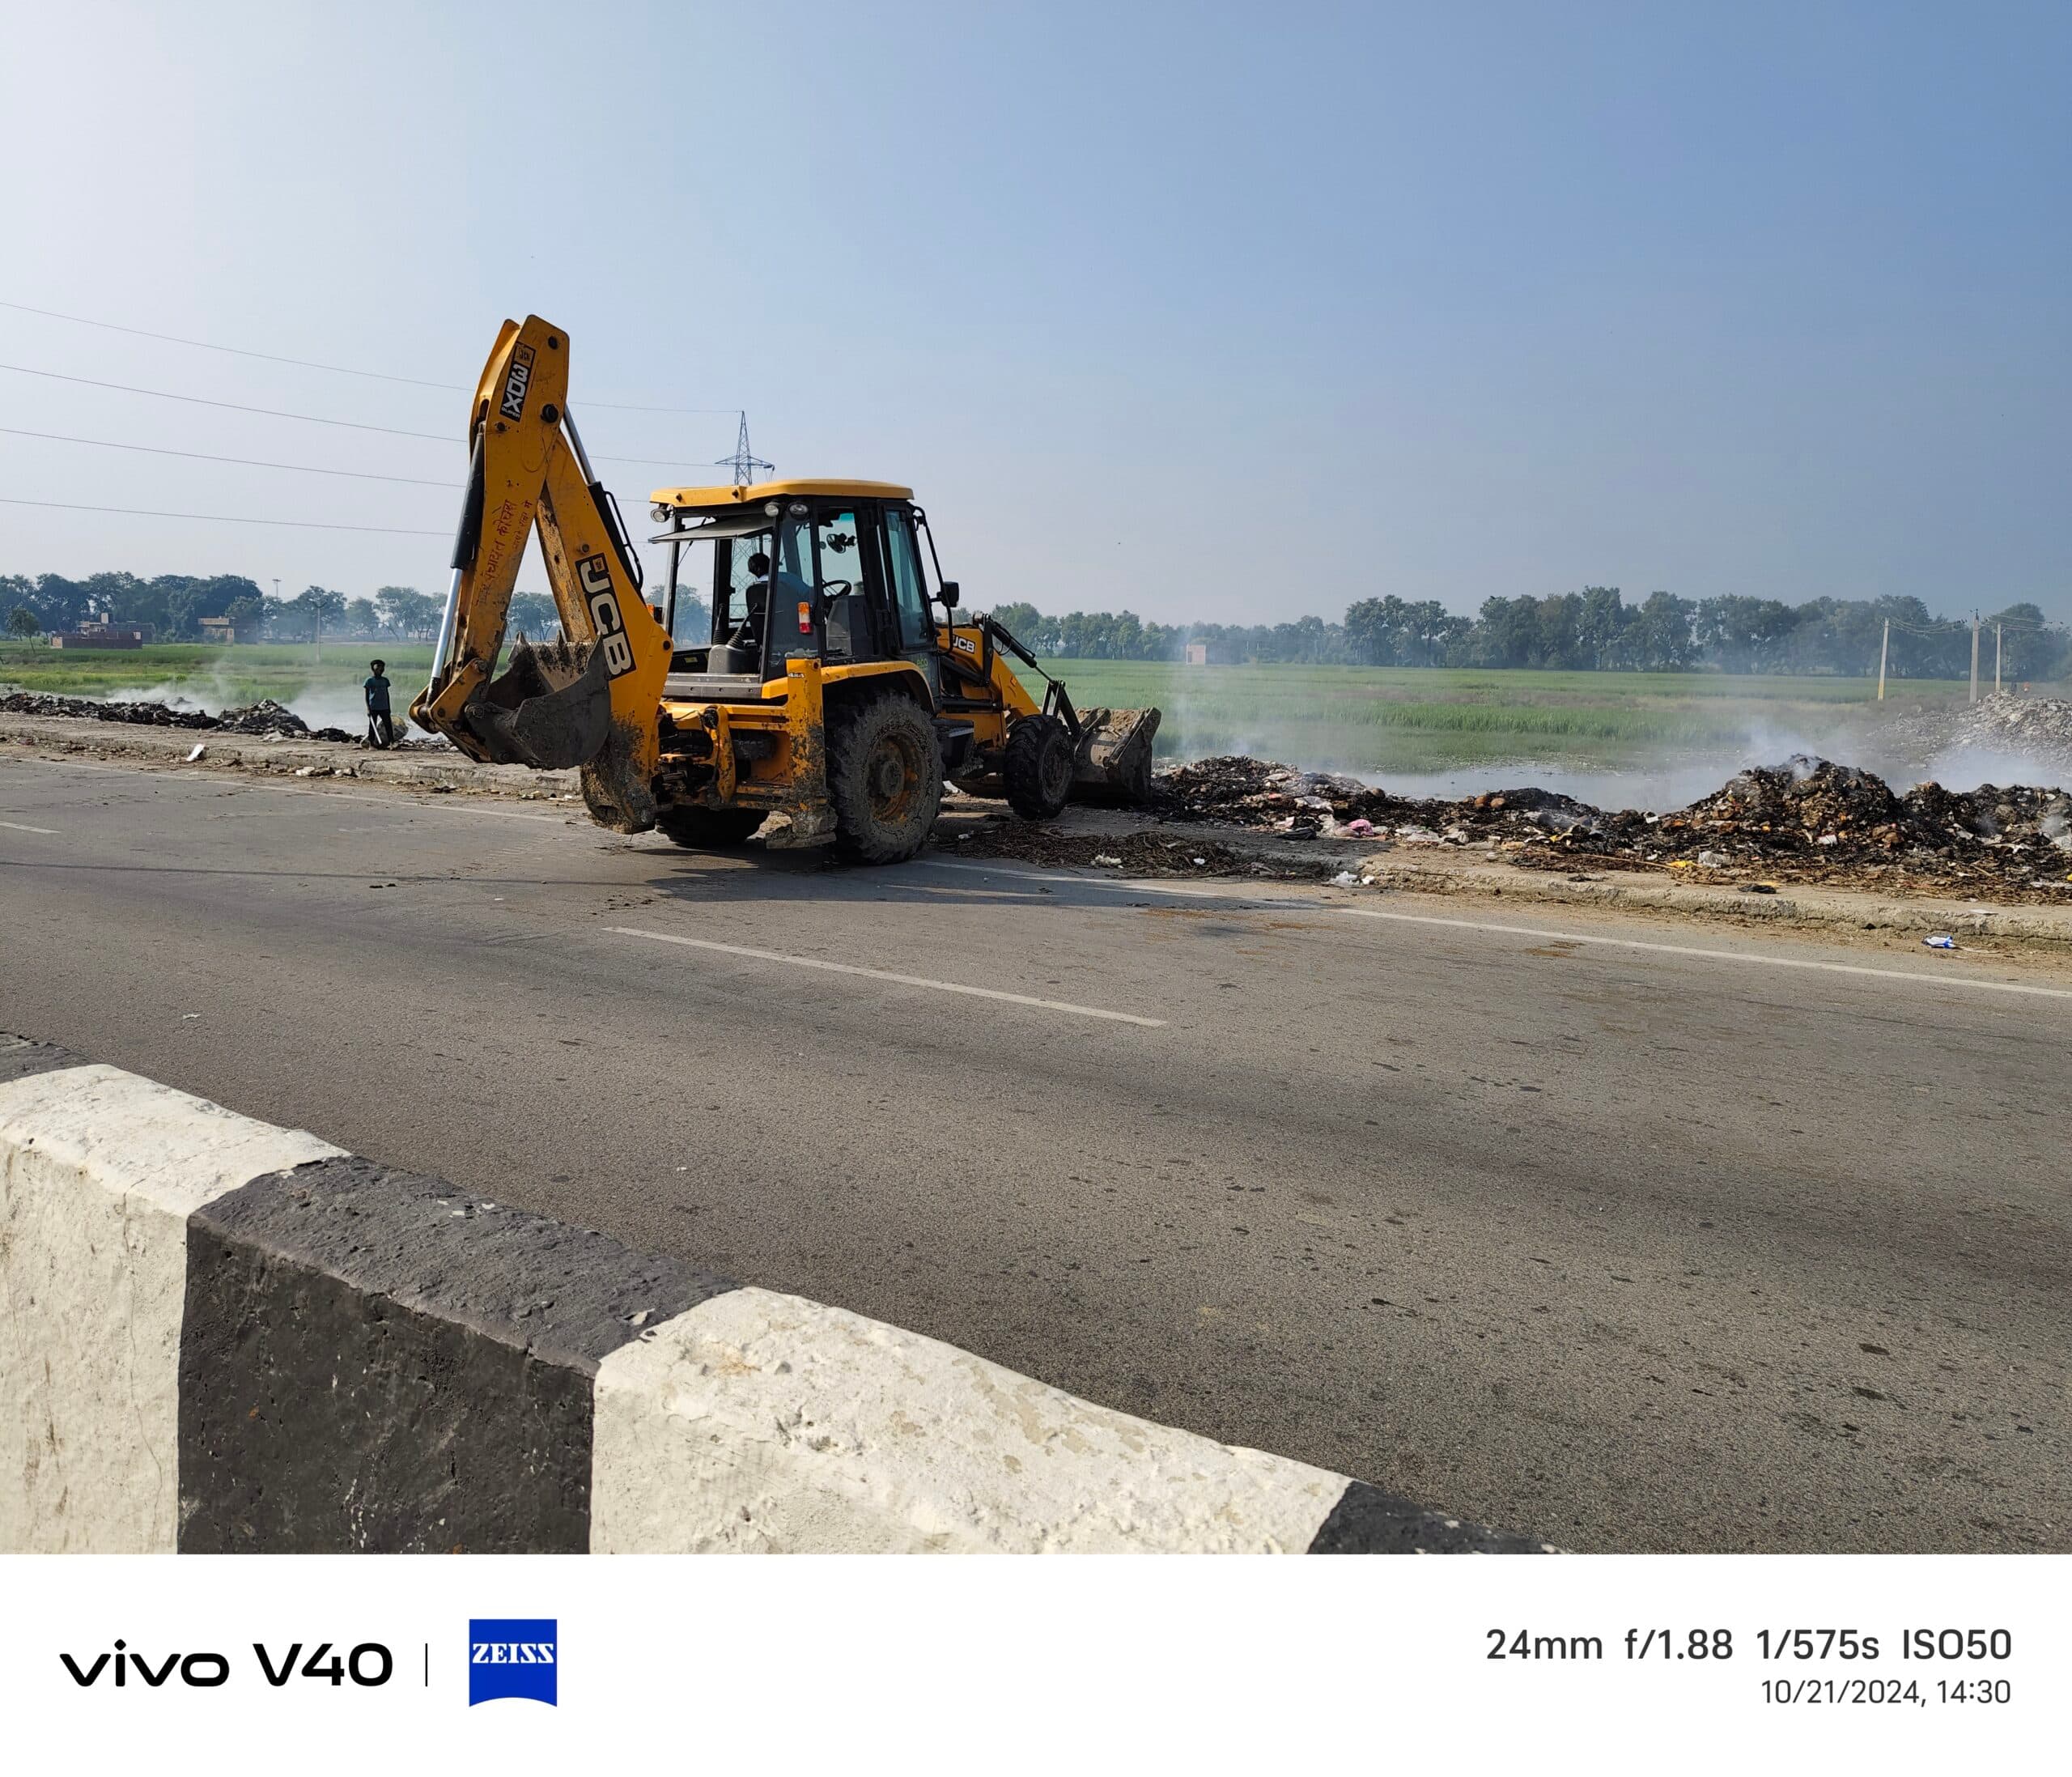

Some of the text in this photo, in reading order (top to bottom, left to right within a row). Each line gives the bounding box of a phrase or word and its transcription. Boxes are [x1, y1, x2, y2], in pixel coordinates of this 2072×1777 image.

[503, 363, 529, 413] 3DX
[580, 561, 632, 676] JCB
[953, 636, 976, 653] JCB
